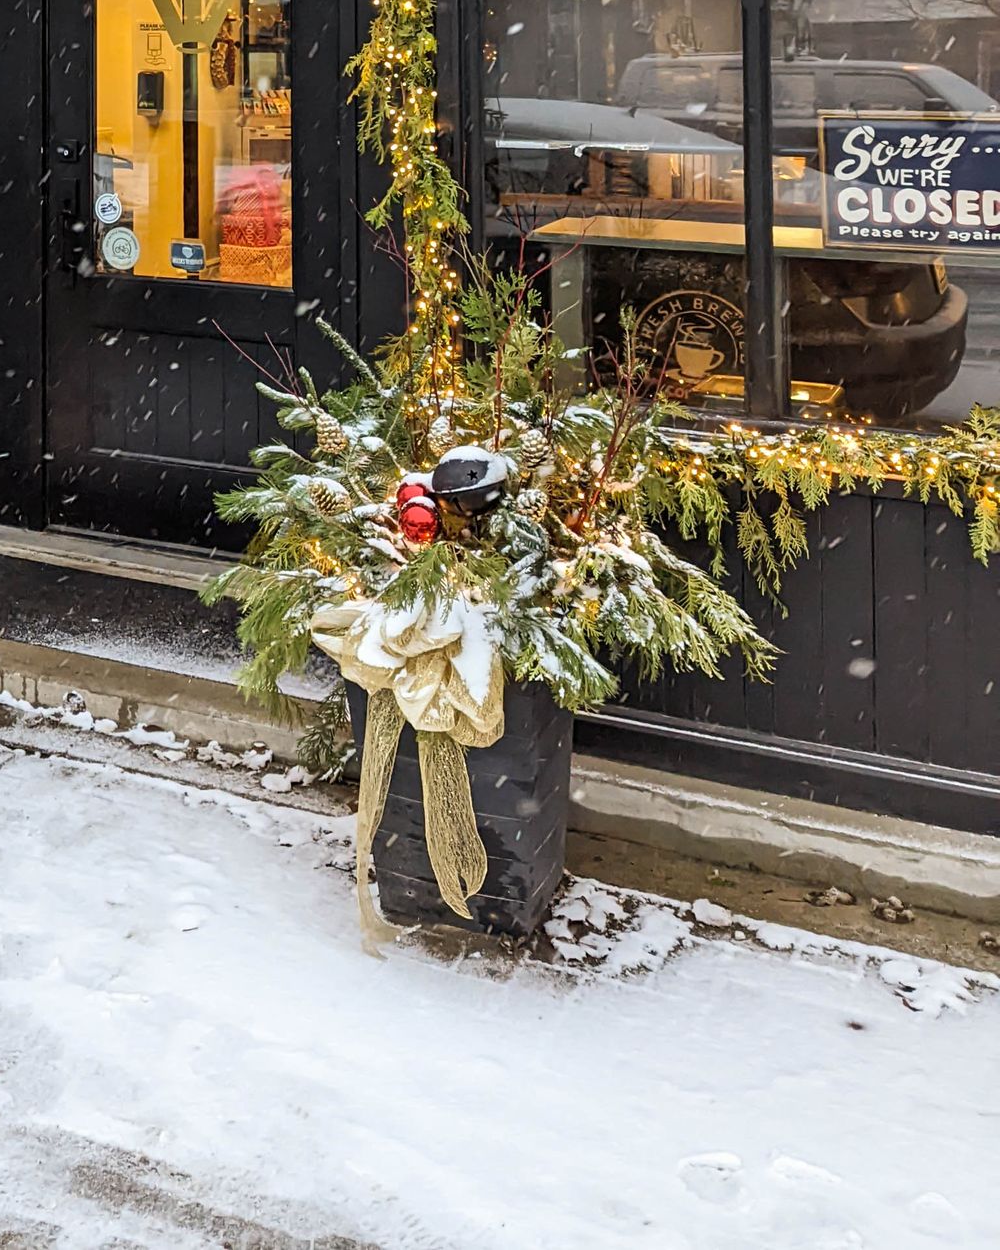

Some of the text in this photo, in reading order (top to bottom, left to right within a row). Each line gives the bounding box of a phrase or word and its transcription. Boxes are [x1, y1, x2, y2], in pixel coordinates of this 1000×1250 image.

[876, 168, 952, 187] WE'RE
[837, 186, 1000, 226] CLOSED
[838, 225, 1000, 242] Please try again
[635, 298, 683, 351] FRESH
